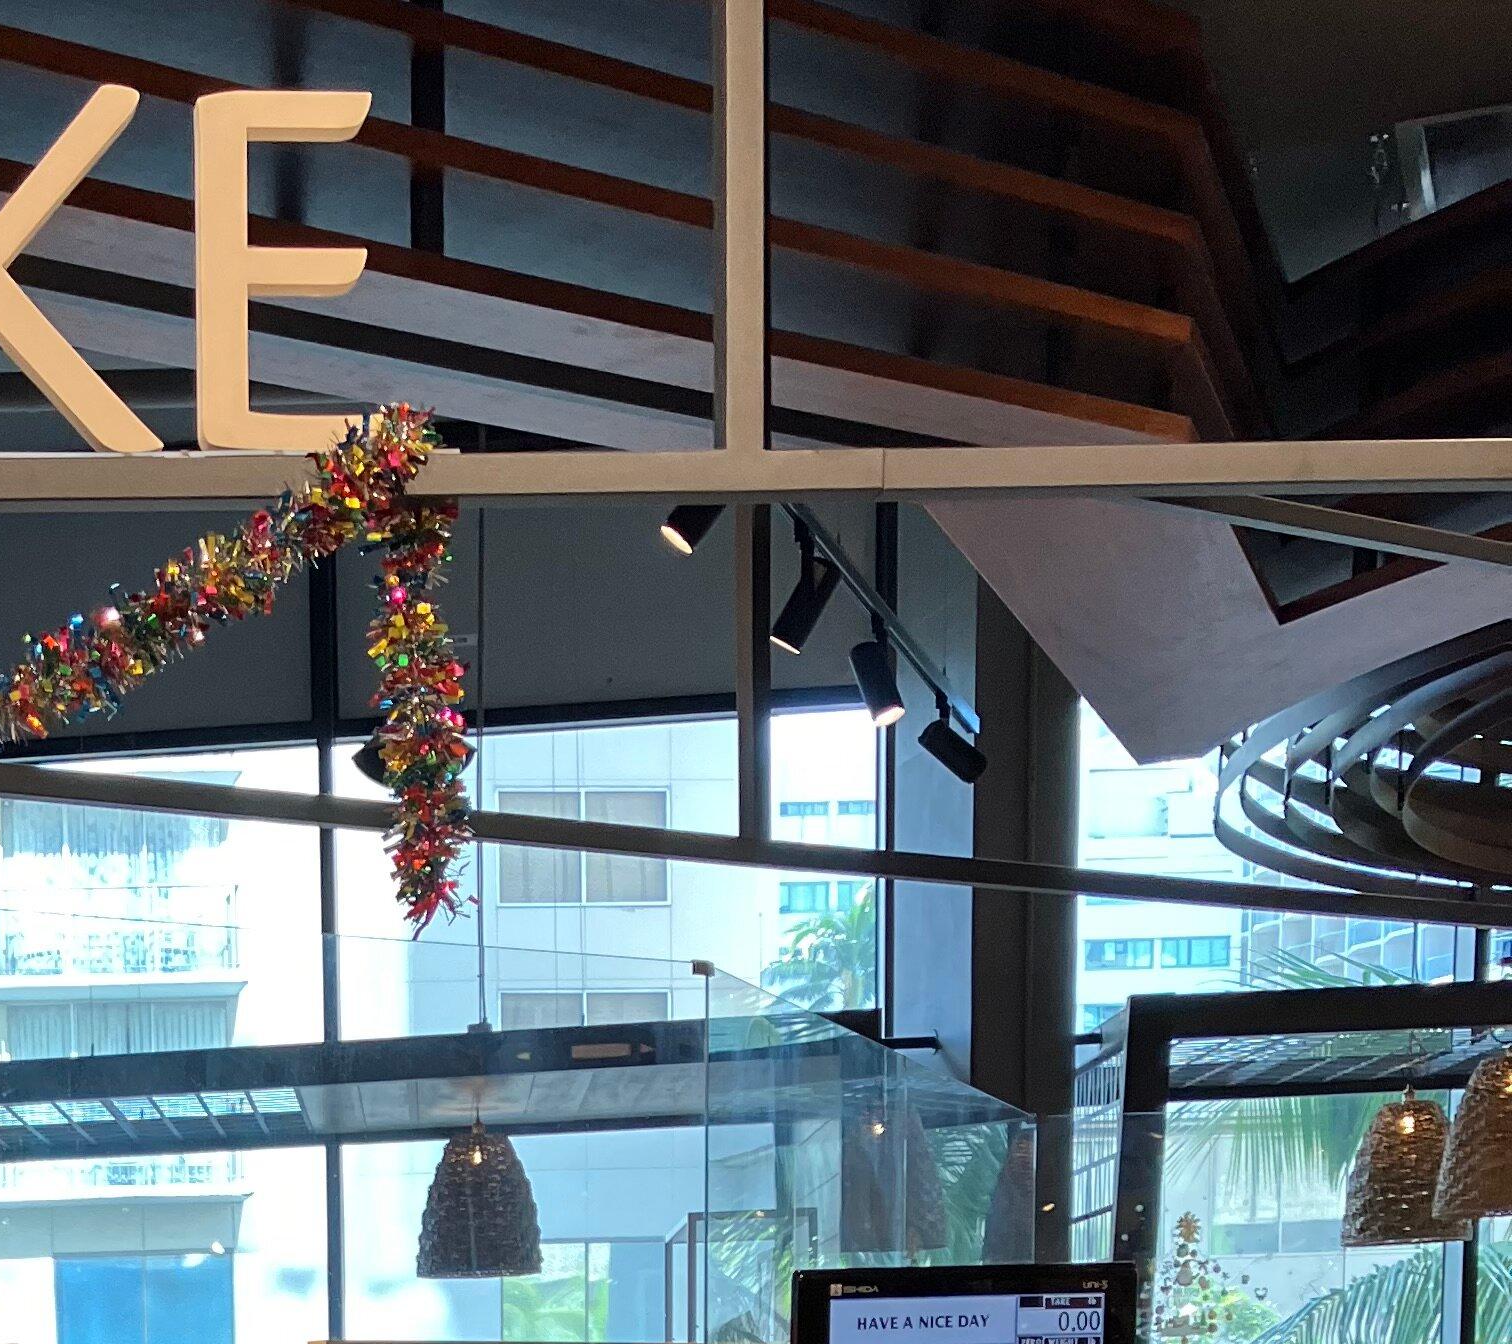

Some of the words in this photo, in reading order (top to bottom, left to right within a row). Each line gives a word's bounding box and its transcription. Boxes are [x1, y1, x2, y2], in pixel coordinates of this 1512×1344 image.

[857, 1316, 898, 1330] HAVE
[903, 1315, 913, 1329] A
[919, 1315, 954, 1328] NICE
[958, 1313, 991, 1328] DAY
[1058, 1310, 1101, 1332] 0.00
